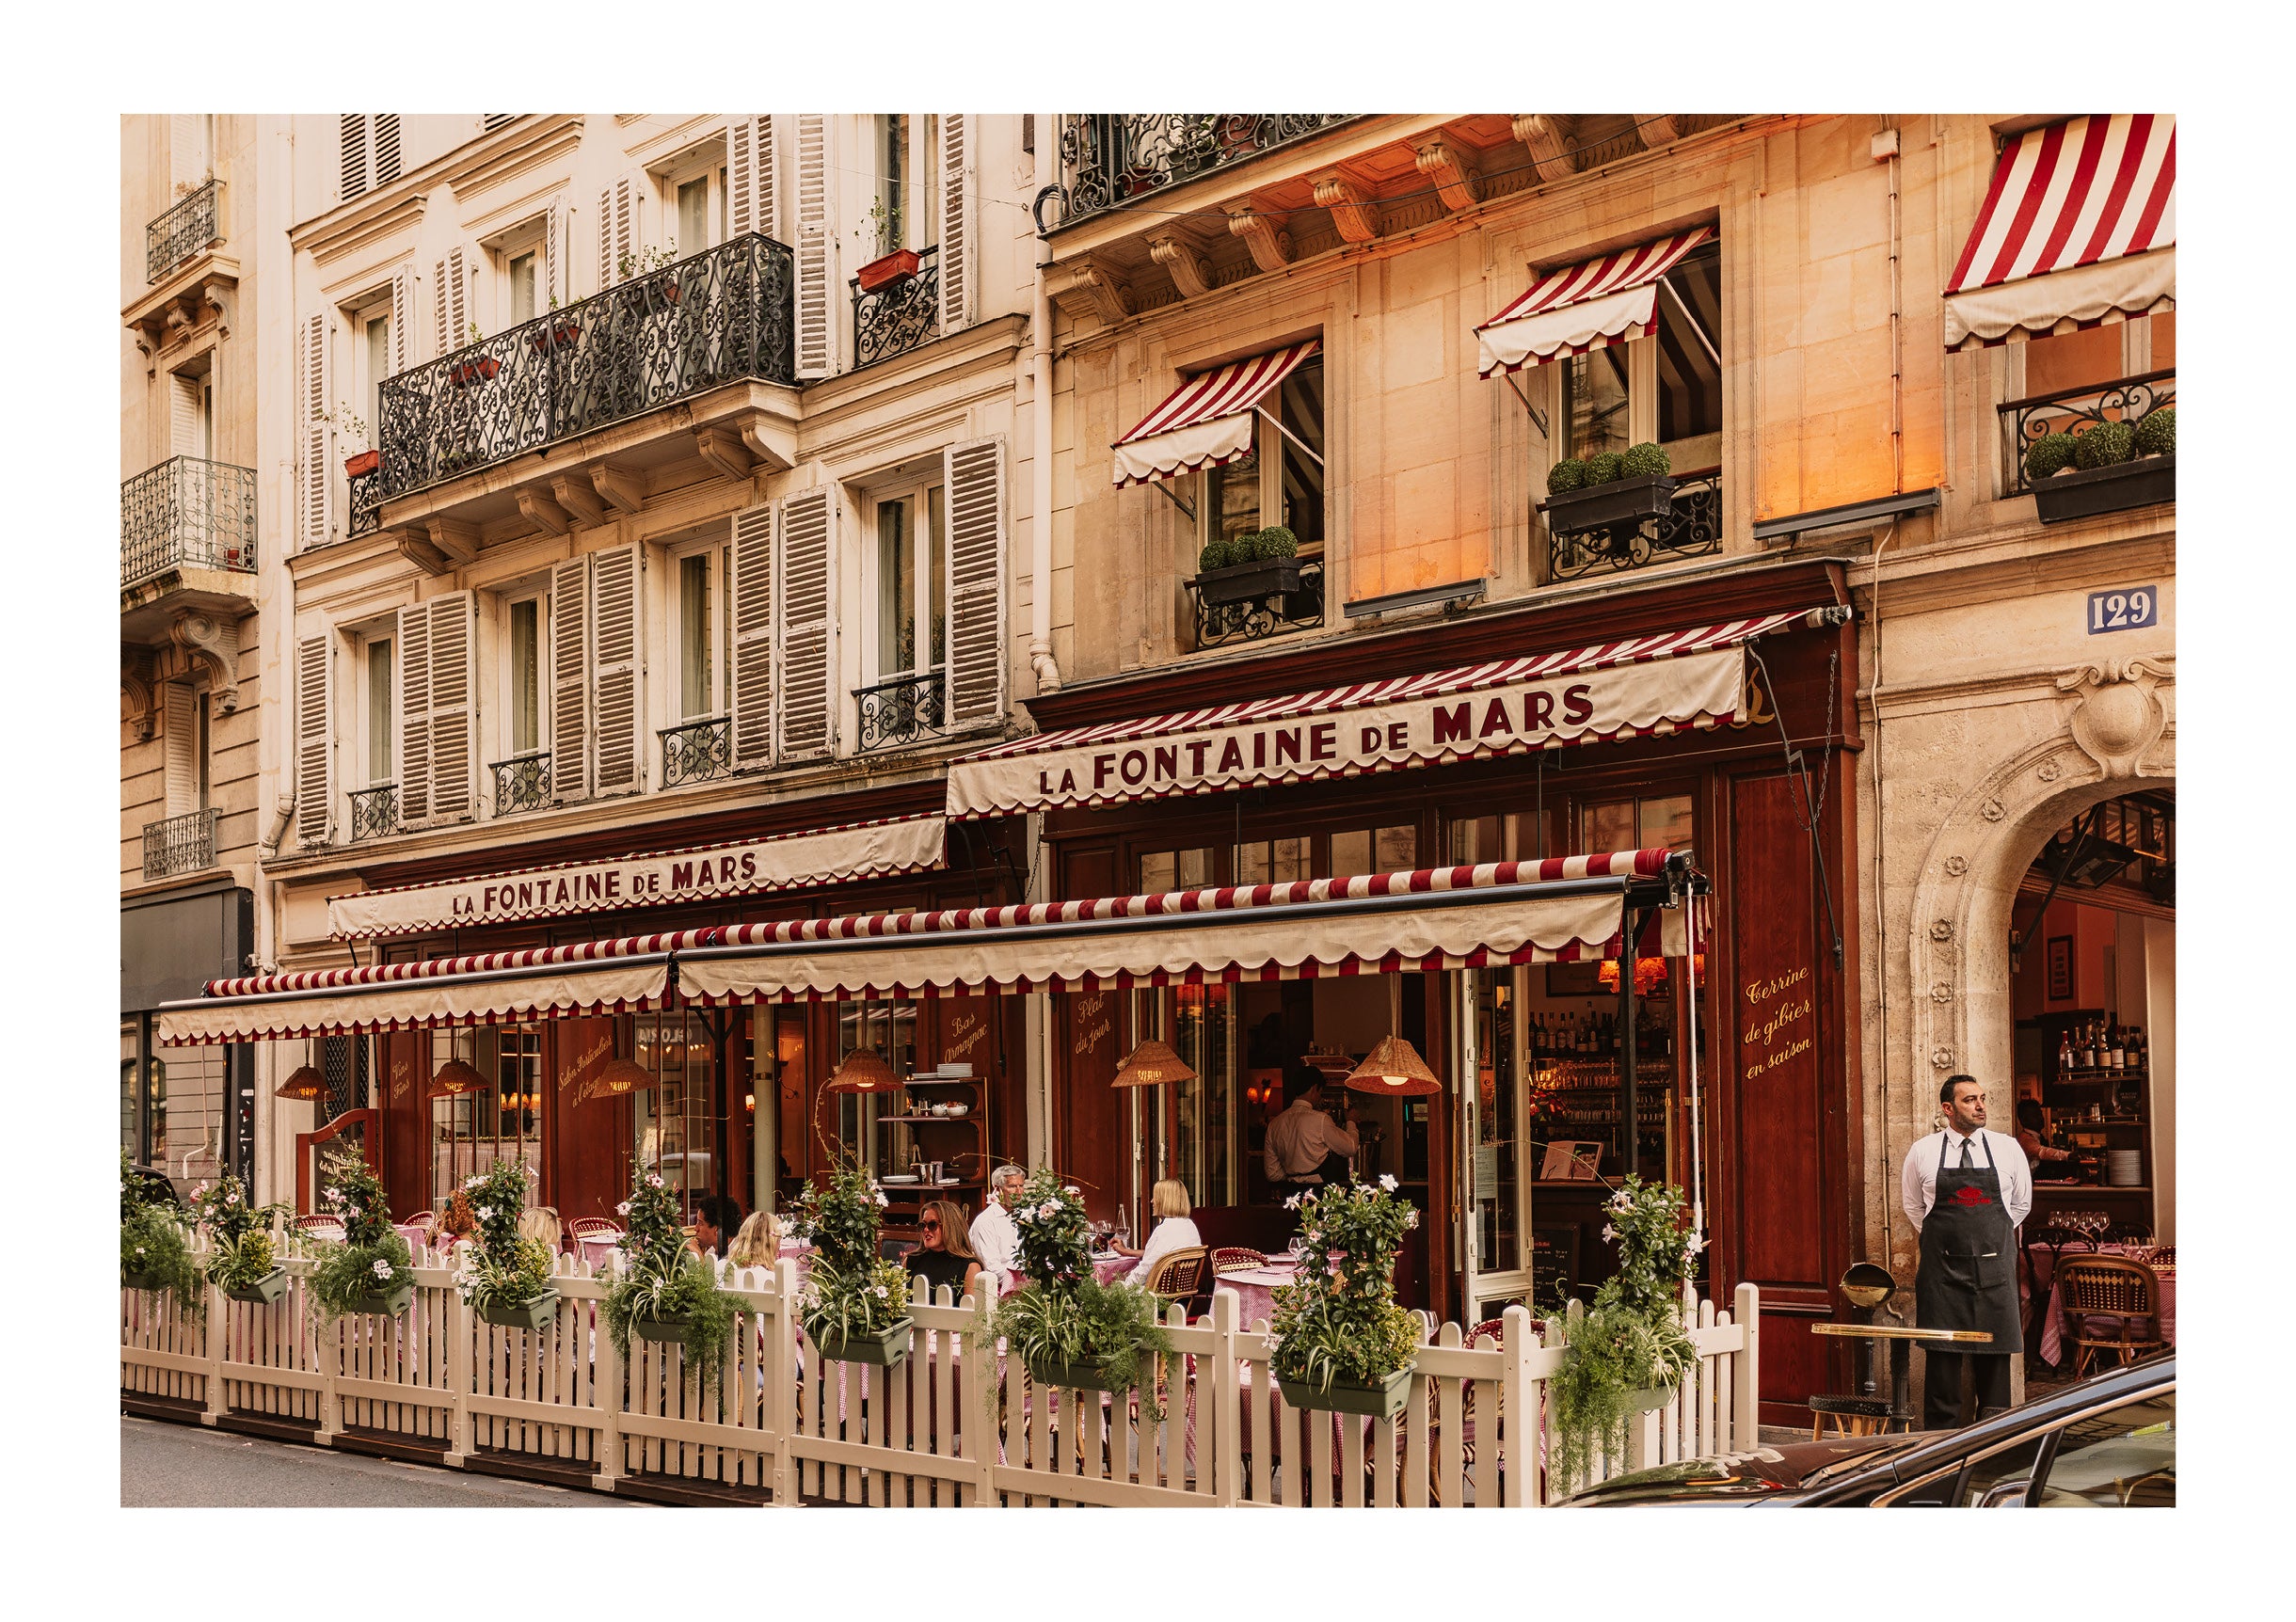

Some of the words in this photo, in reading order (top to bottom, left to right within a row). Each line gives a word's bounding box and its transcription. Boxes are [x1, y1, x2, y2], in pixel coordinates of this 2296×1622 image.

[2093, 591, 2151, 629] 129
[1039, 768, 1077, 795] LA
[1093, 722, 1336, 789] FONTAINE
[1361, 721, 1409, 755] DE
[1432, 684, 1594, 744] MARS
[453, 897, 474, 915] LA
[484, 870, 620, 913] FONTAINE
[632, 872, 660, 895] DE
[671, 851, 757, 891] MARS
[1746, 966, 1809, 1004] Terrine
[951, 1011, 976, 1038] Bas
[1077, 991, 1106, 1025] Plat
[1745, 1023, 1762, 1044] de
[1763, 999, 1811, 1046] gibier
[1076, 1032, 1089, 1055] du
[1088, 1018, 1111, 1055] jour
[1746, 1064, 1765, 1080] en
[1767, 1038, 1811, 1069] saison
